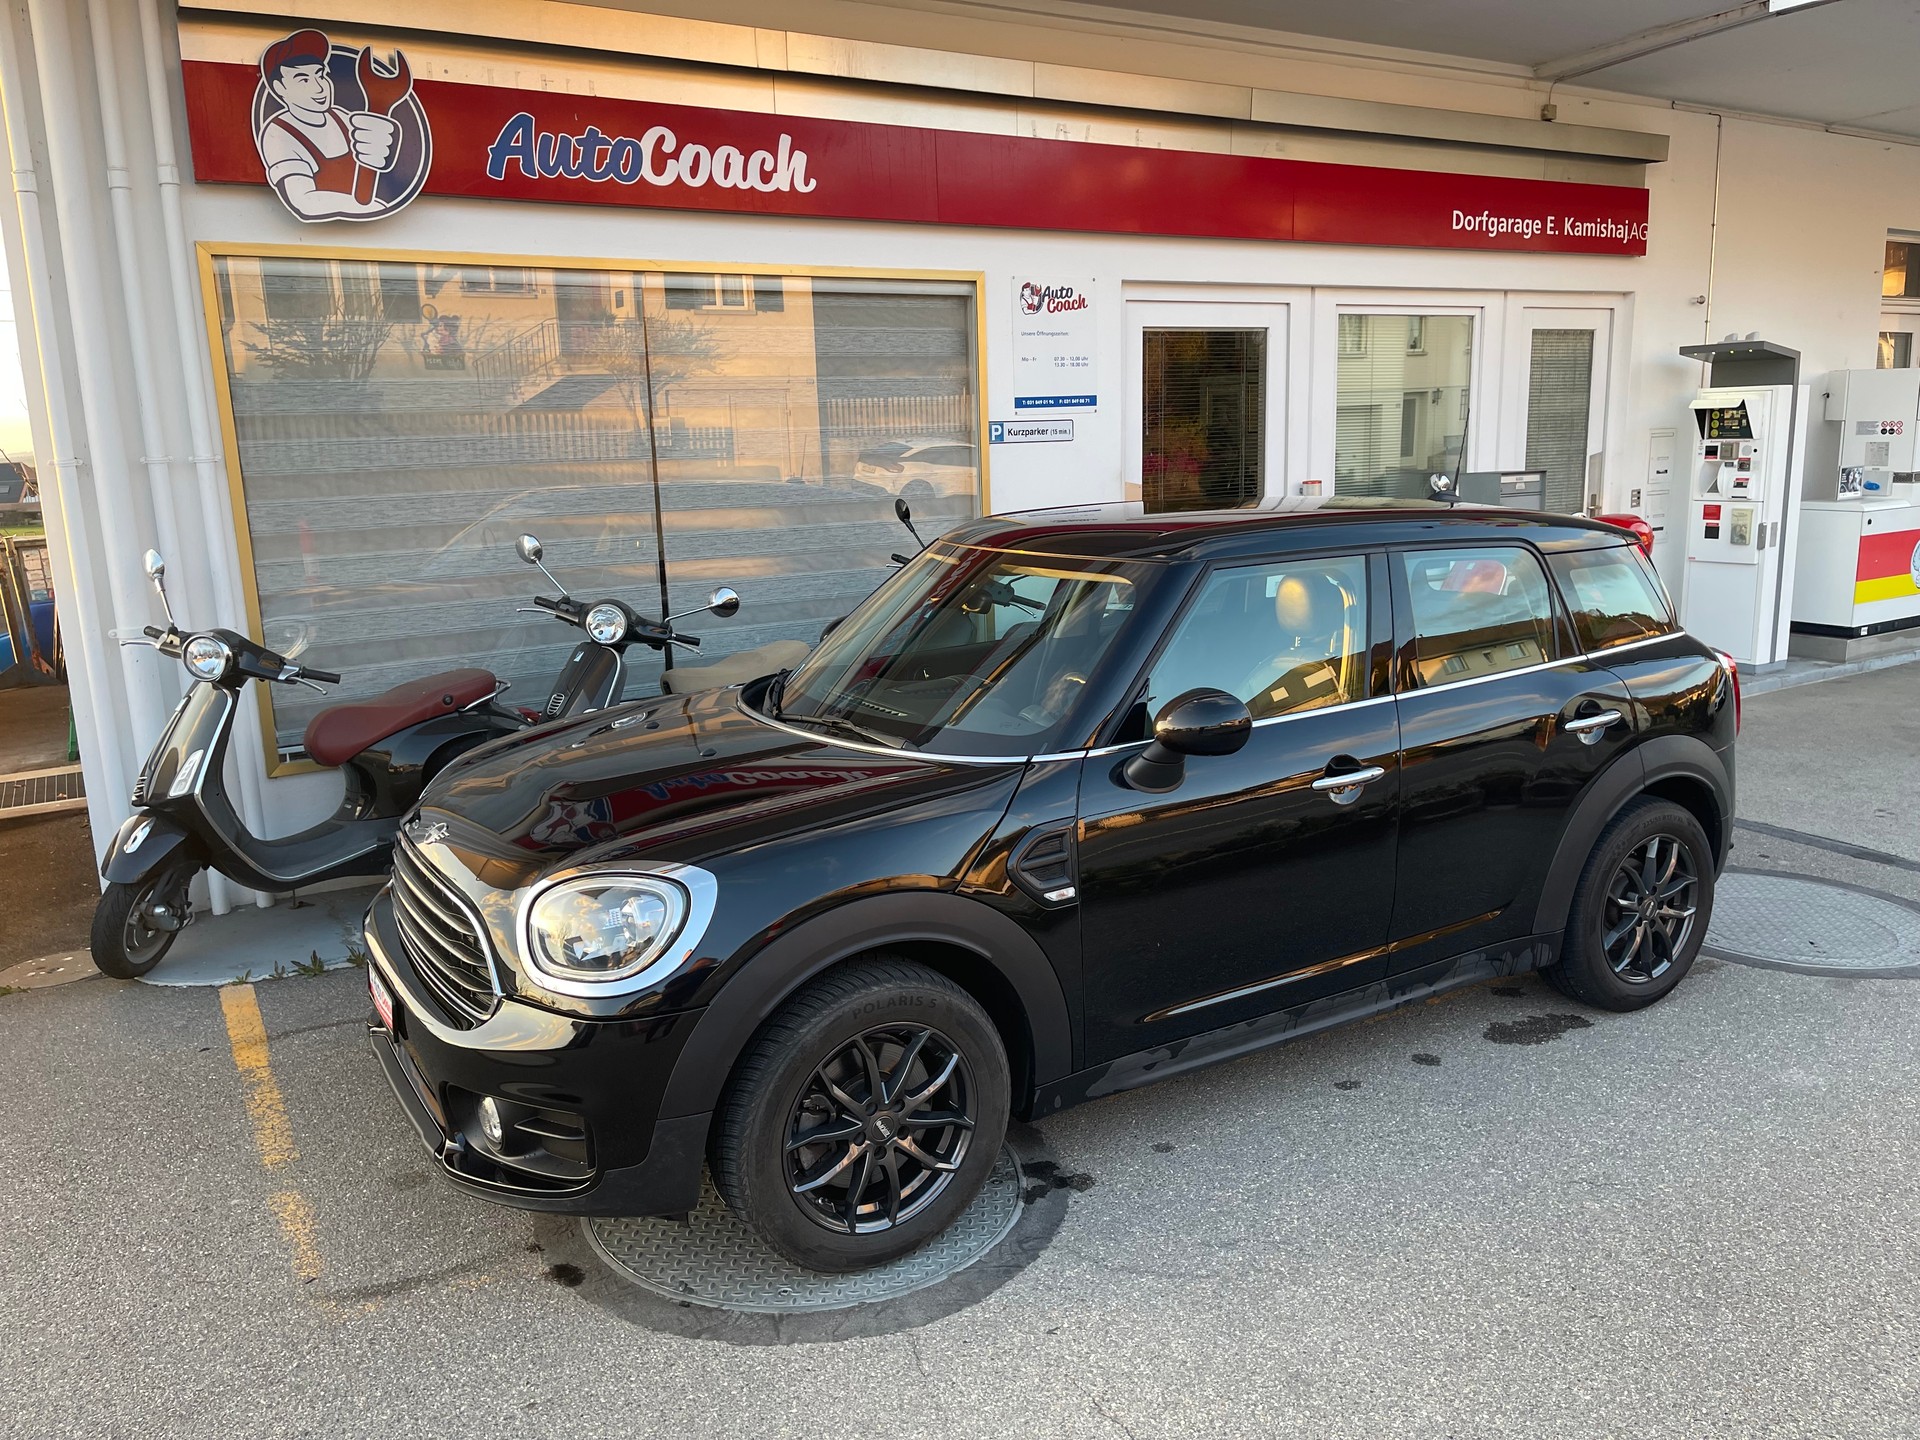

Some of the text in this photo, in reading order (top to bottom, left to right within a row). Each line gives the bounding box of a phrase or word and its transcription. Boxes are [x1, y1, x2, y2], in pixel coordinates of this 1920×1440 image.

[486, 111, 817, 193] AutoCoach
[1452, 210, 1649, 244] Dorfgarage E. Kamishaj AG
[1042, 286, 1073, 302] Auto
[1047, 293, 1089, 314] Coach
[991, 424, 1002, 441] P
[1007, 428, 1049, 437] Kurzparker
[851, 995, 924, 1019] POLARIS
